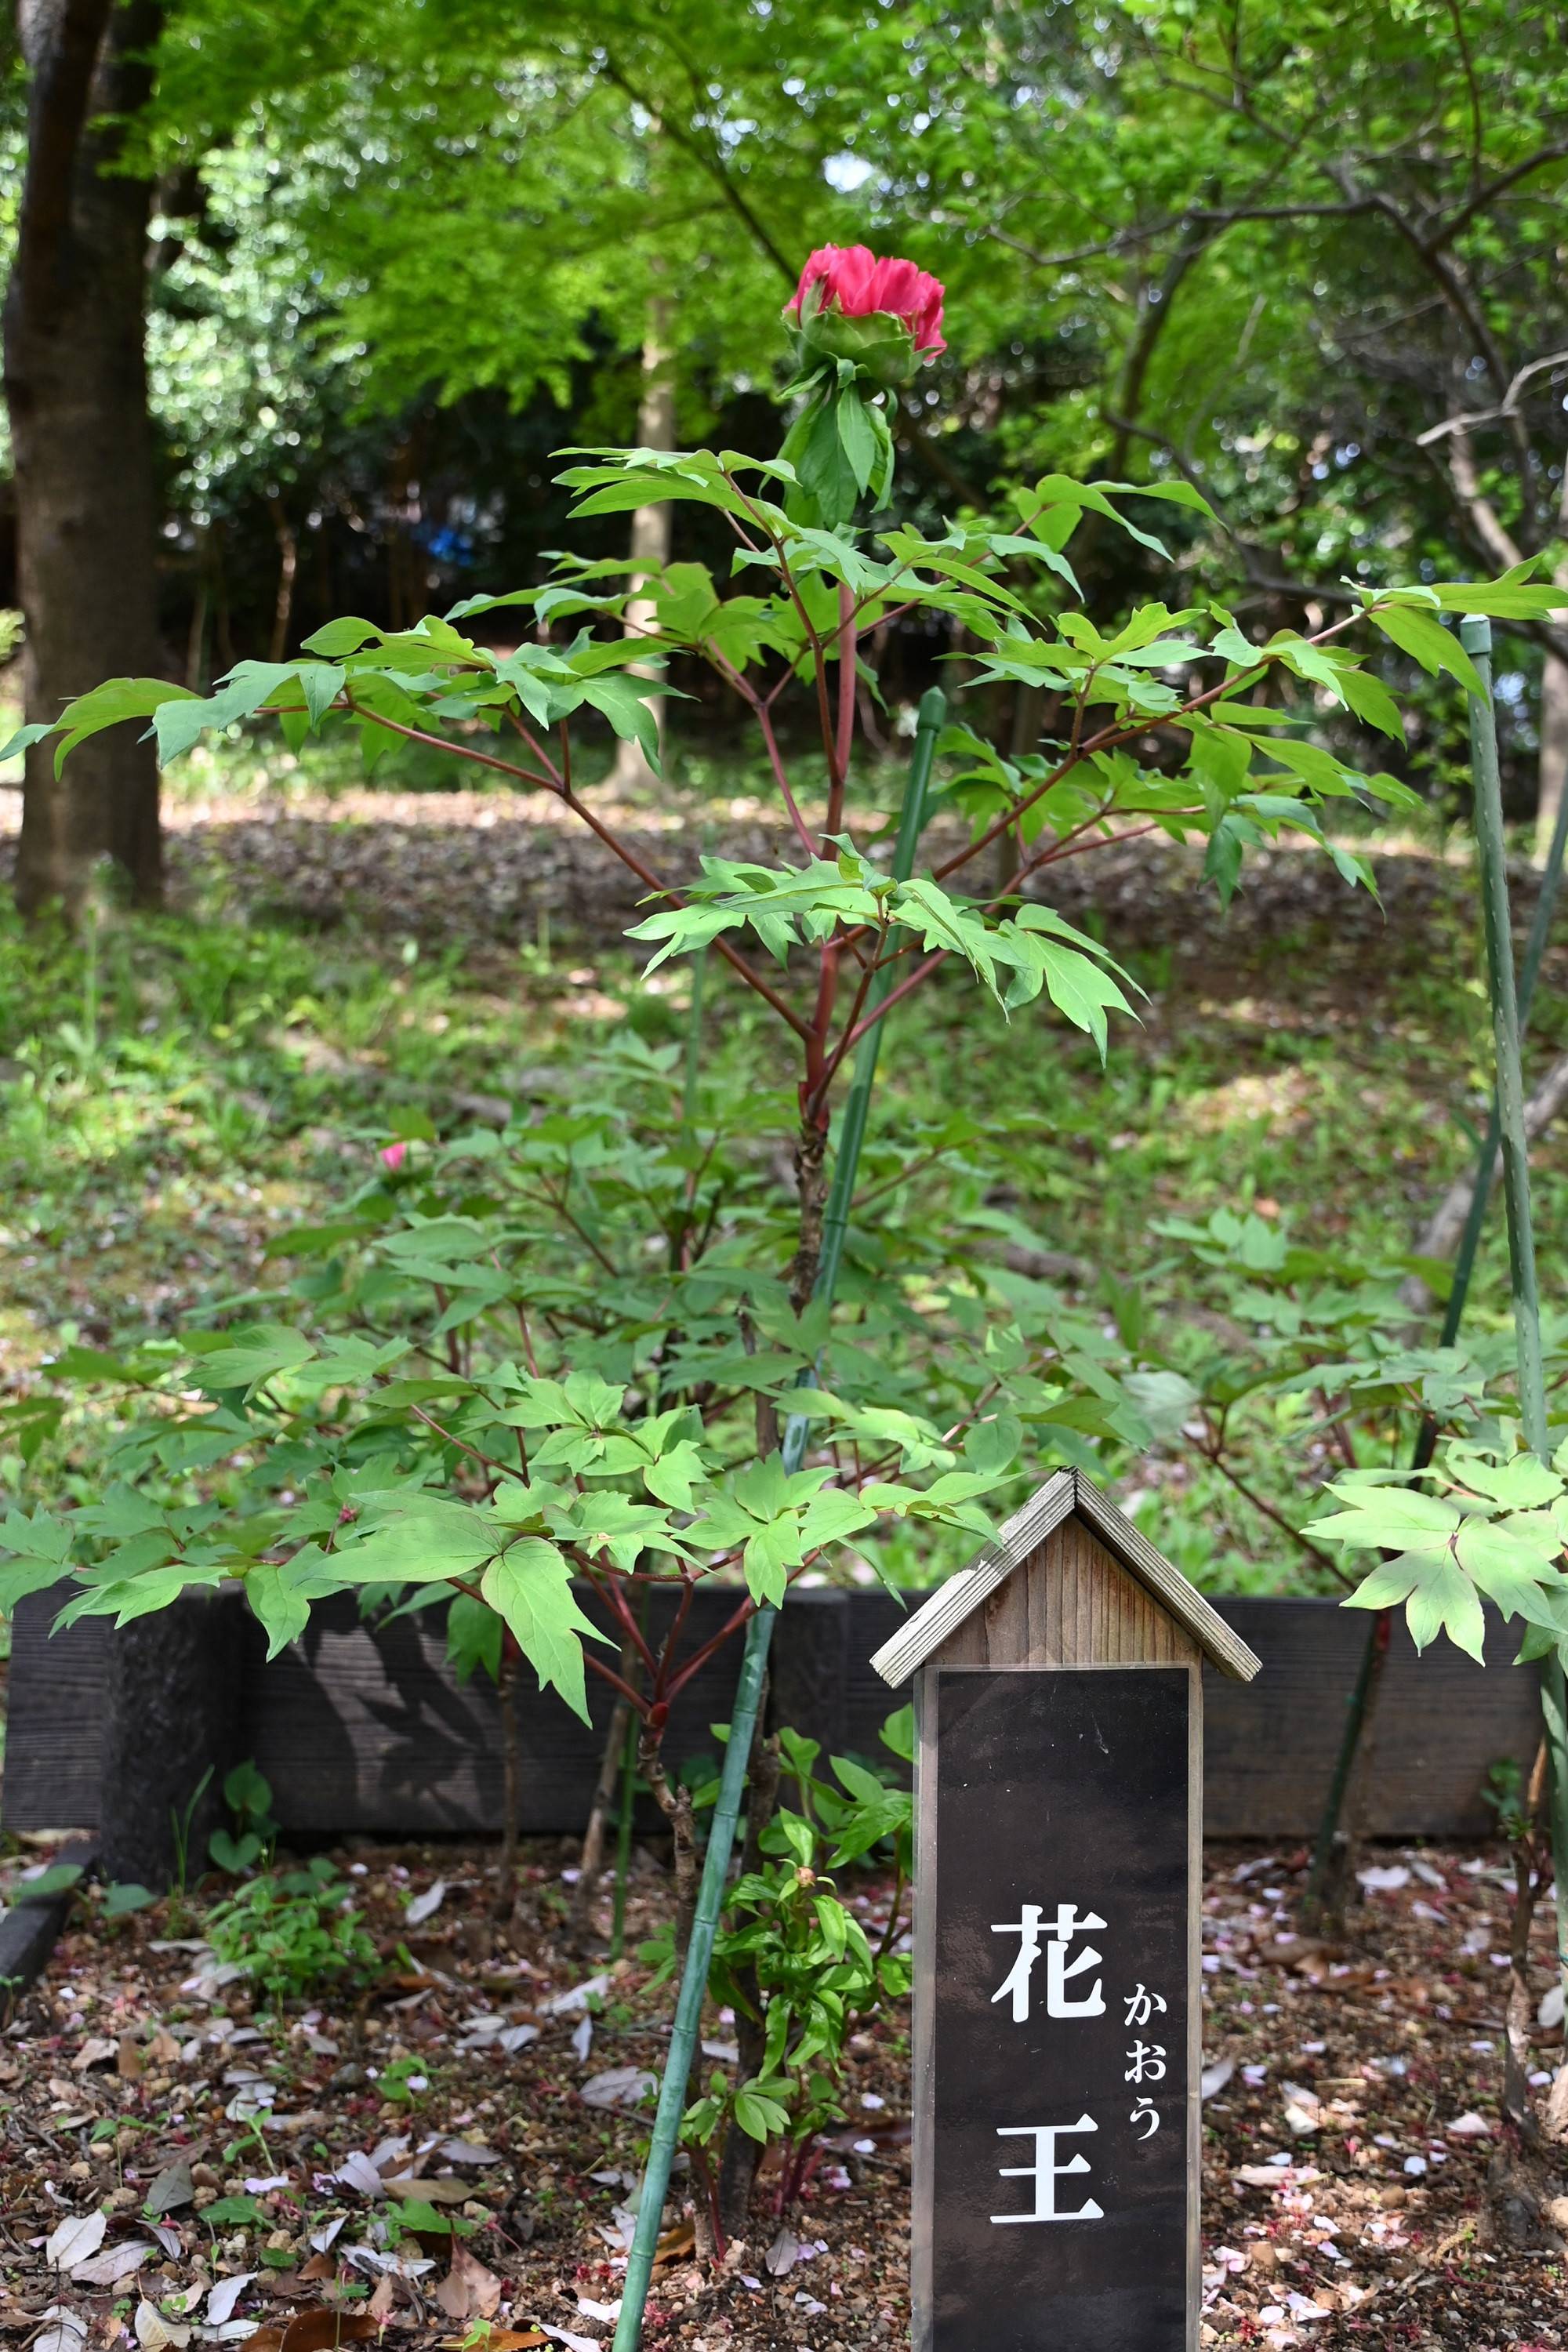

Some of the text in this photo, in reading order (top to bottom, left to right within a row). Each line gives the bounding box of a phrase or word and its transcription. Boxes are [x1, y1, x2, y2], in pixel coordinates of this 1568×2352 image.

[989, 1904, 1108, 2224] 花王
[1123, 1983, 1167, 2140] かおう
